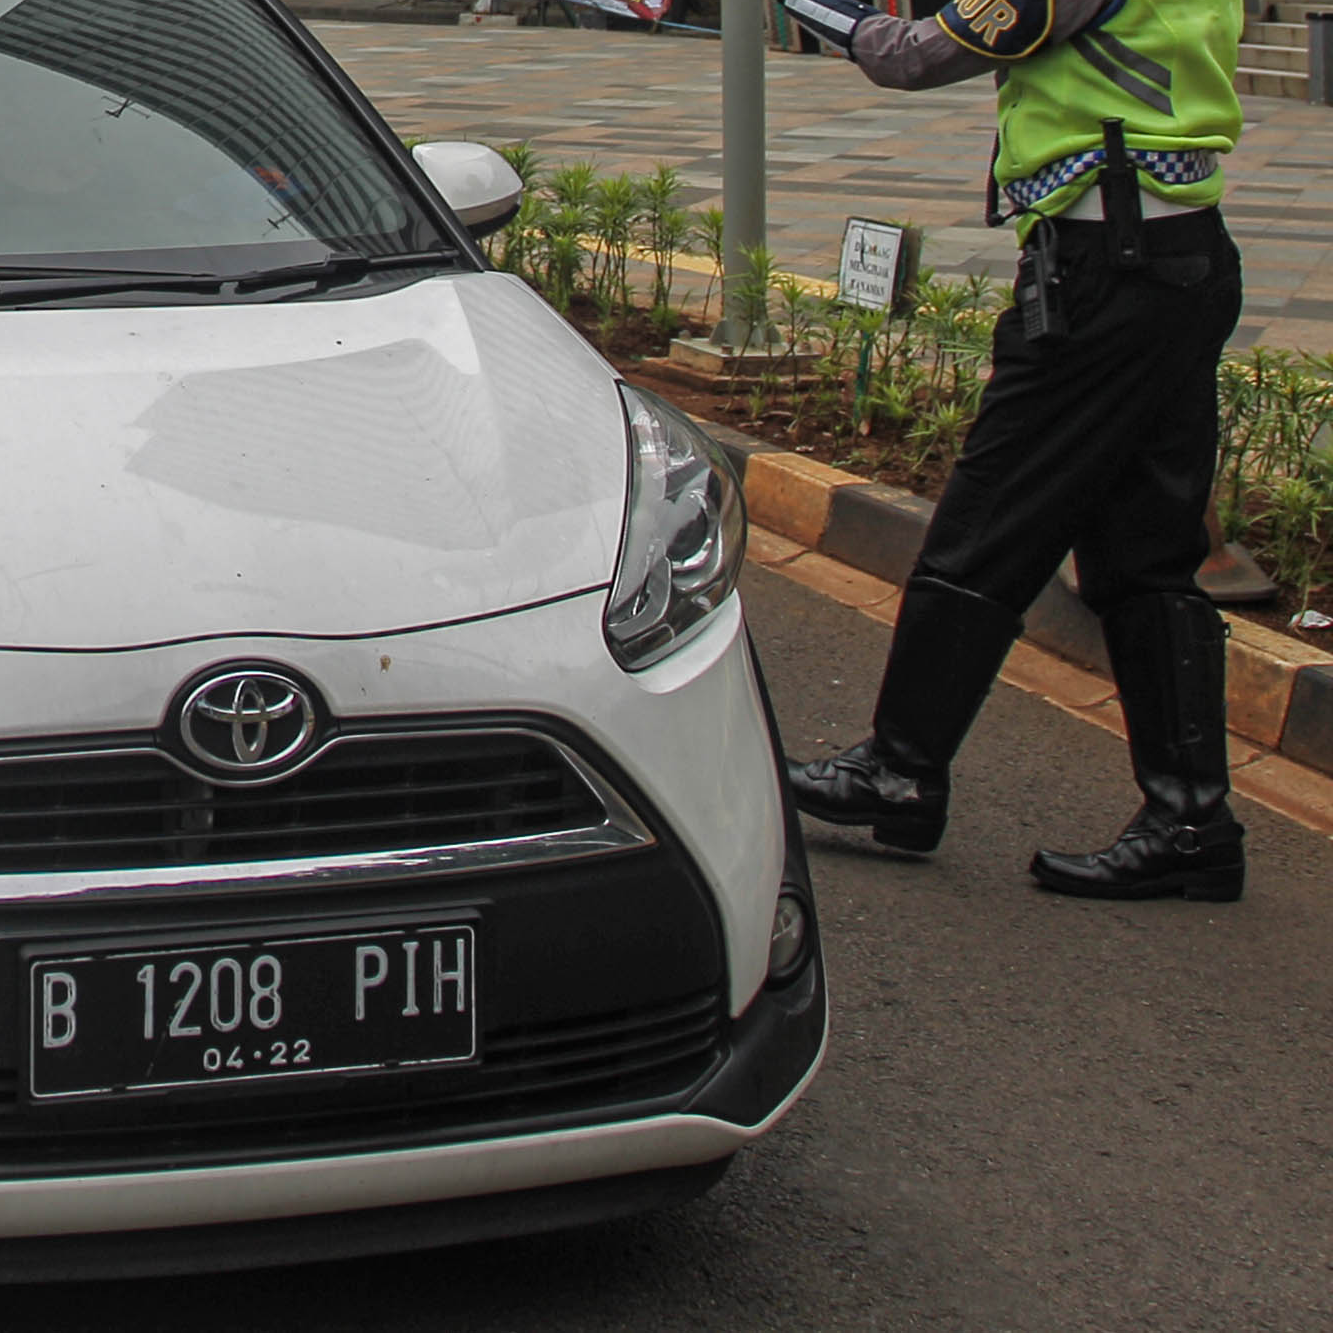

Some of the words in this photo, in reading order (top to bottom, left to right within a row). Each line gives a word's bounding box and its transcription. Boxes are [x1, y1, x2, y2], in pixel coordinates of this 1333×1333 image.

[42, 972, 77, 1049] B
[136, 954, 282, 1040] 1208
[354, 937, 465, 1021] PIH
